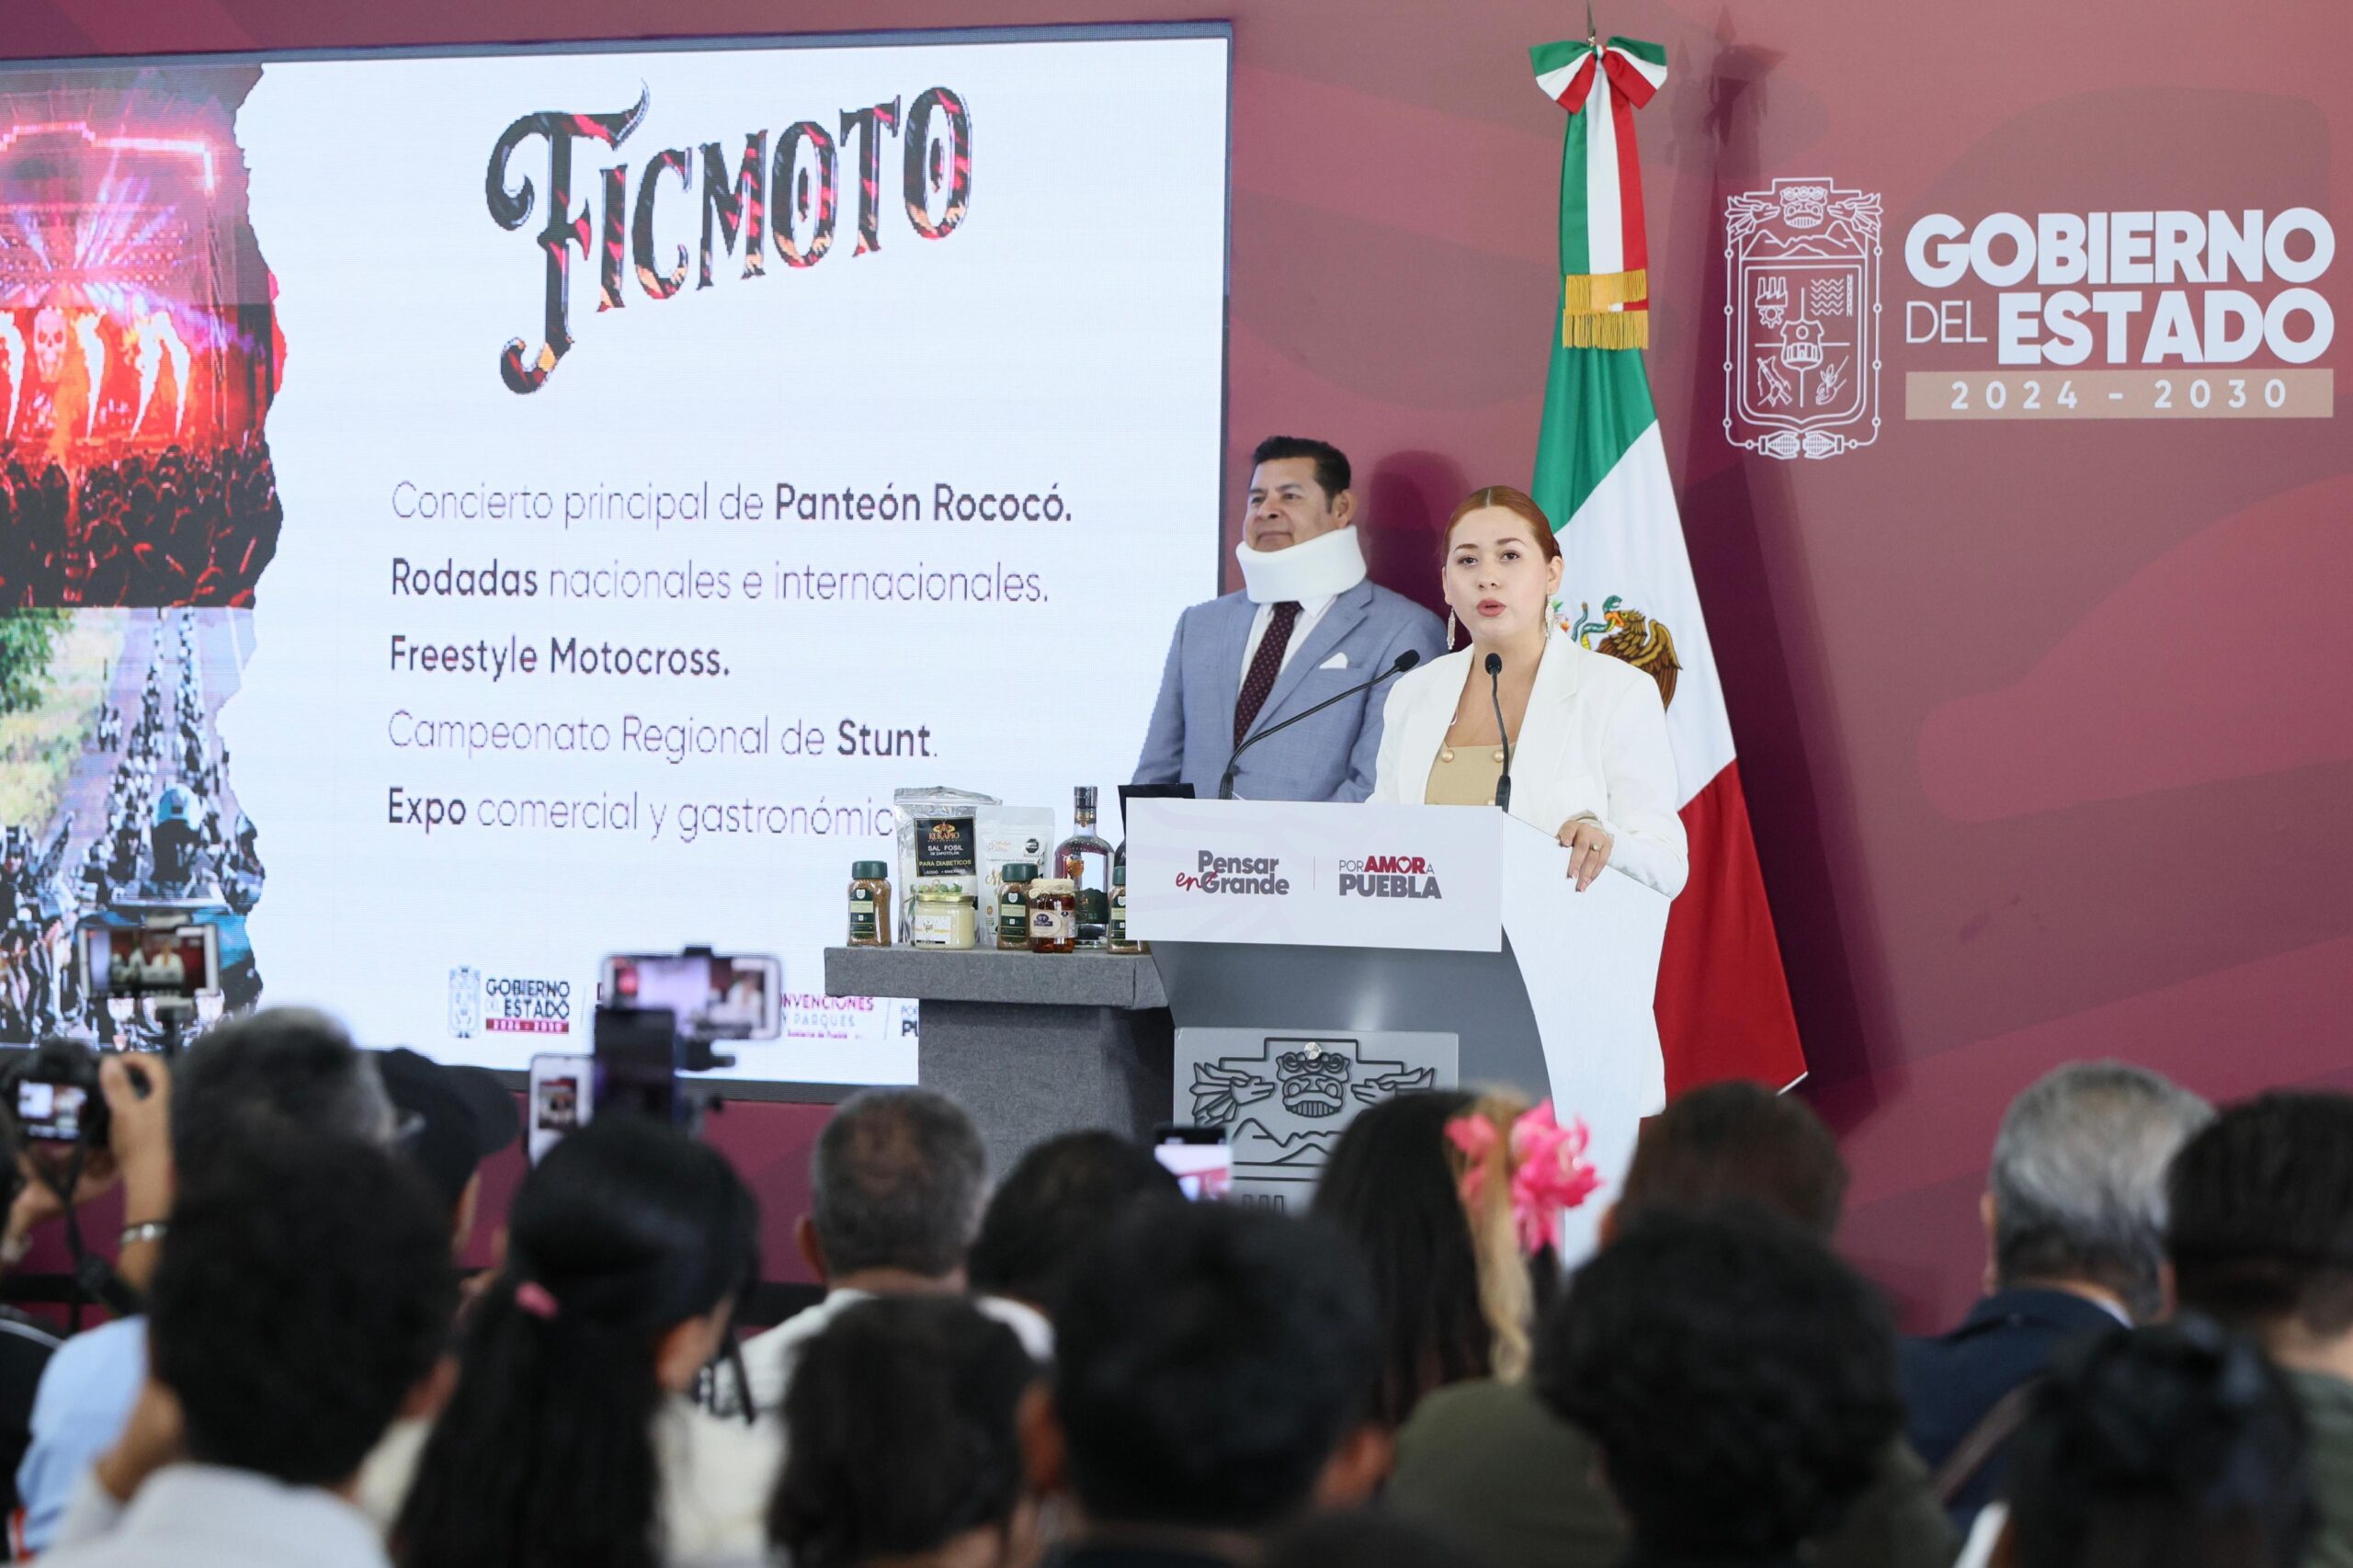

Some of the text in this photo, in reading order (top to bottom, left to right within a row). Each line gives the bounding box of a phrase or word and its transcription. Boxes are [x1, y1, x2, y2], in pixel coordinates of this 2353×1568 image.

[484, 79, 972, 395] FICMOTO
[1905, 208, 2336, 288] GOBIERNO
[1906, 288, 2335, 366] DEL ESTADO
[1950, 381, 2078, 411] 2024
[2154, 378, 2287, 409] 2030
[392, 481, 1072, 530] Concierto principal de Panteón Rococó.
[392, 557, 1049, 602] Rodadas nacionales e internacionales.
[391, 634, 730, 682] Freestyle Motocross.
[389, 709, 938, 764] Campeonato Regional de Stunt.
[389, 786, 893, 844] Expo comercial y gastronómic
[1198, 850, 1279, 874] Pensar
[1339, 856, 1435, 874] POR AMOR A
[1176, 870, 1290, 895] en Grande
[1339, 874, 1442, 899] PUEBLA
[486, 978, 570, 998] GOBIERNO
[780, 994, 873, 1010] NVENCIONES
[505, 998, 570, 1019] ESTADO
